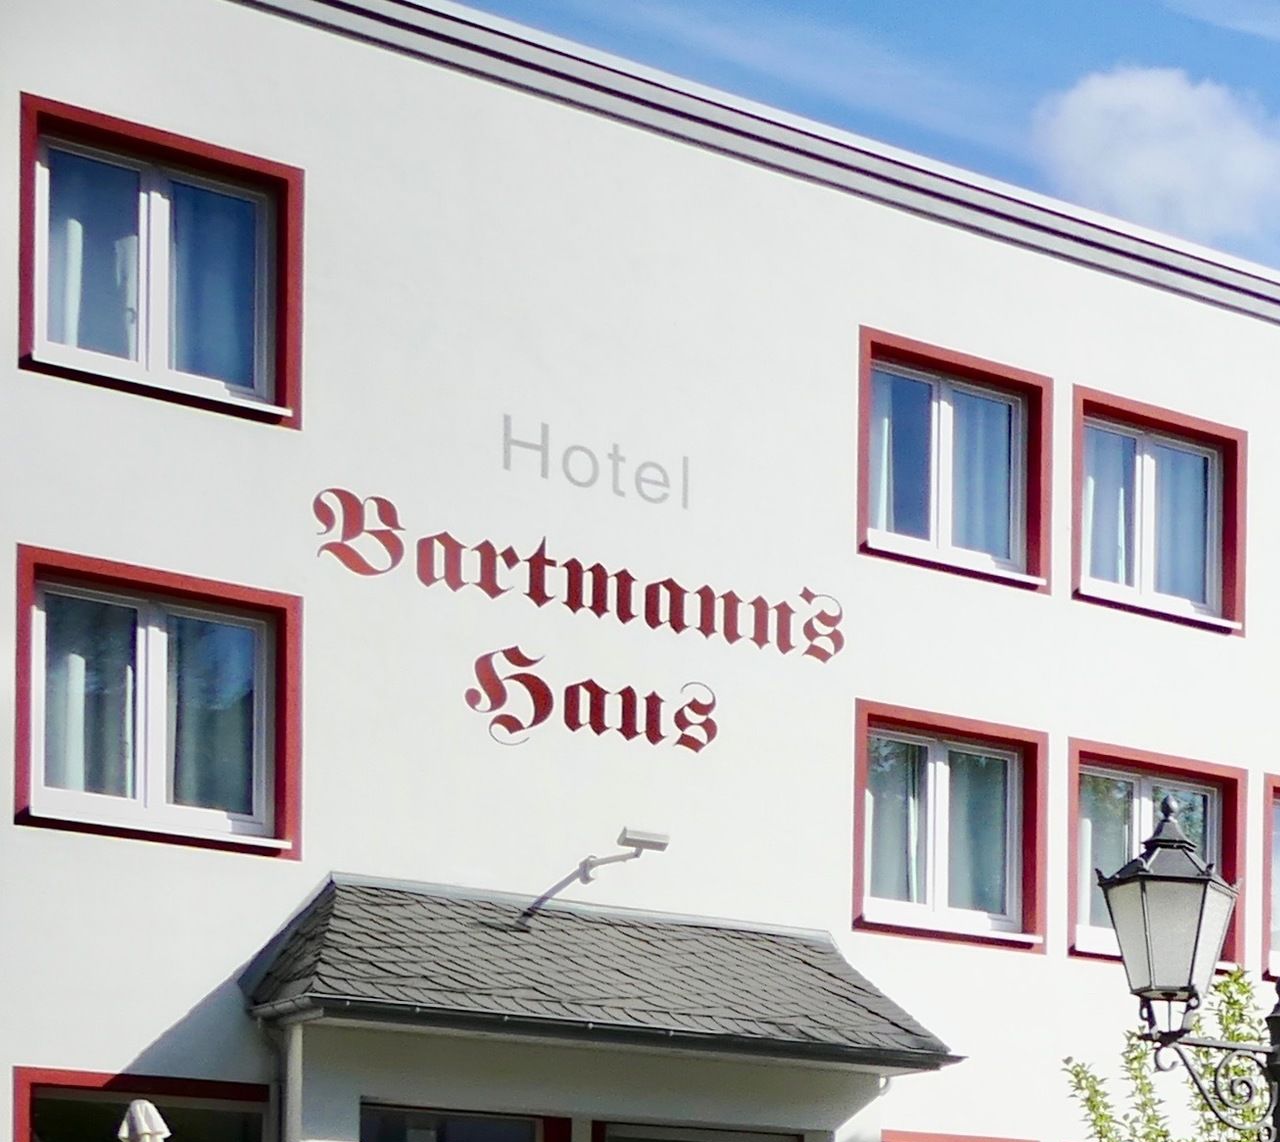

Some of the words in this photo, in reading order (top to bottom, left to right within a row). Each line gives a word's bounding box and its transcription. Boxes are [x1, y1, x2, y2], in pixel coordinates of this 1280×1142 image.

[502, 413, 690, 510] Hotel
[312, 487, 846, 664] Bartmann's
[464, 645, 718, 754] Haus
